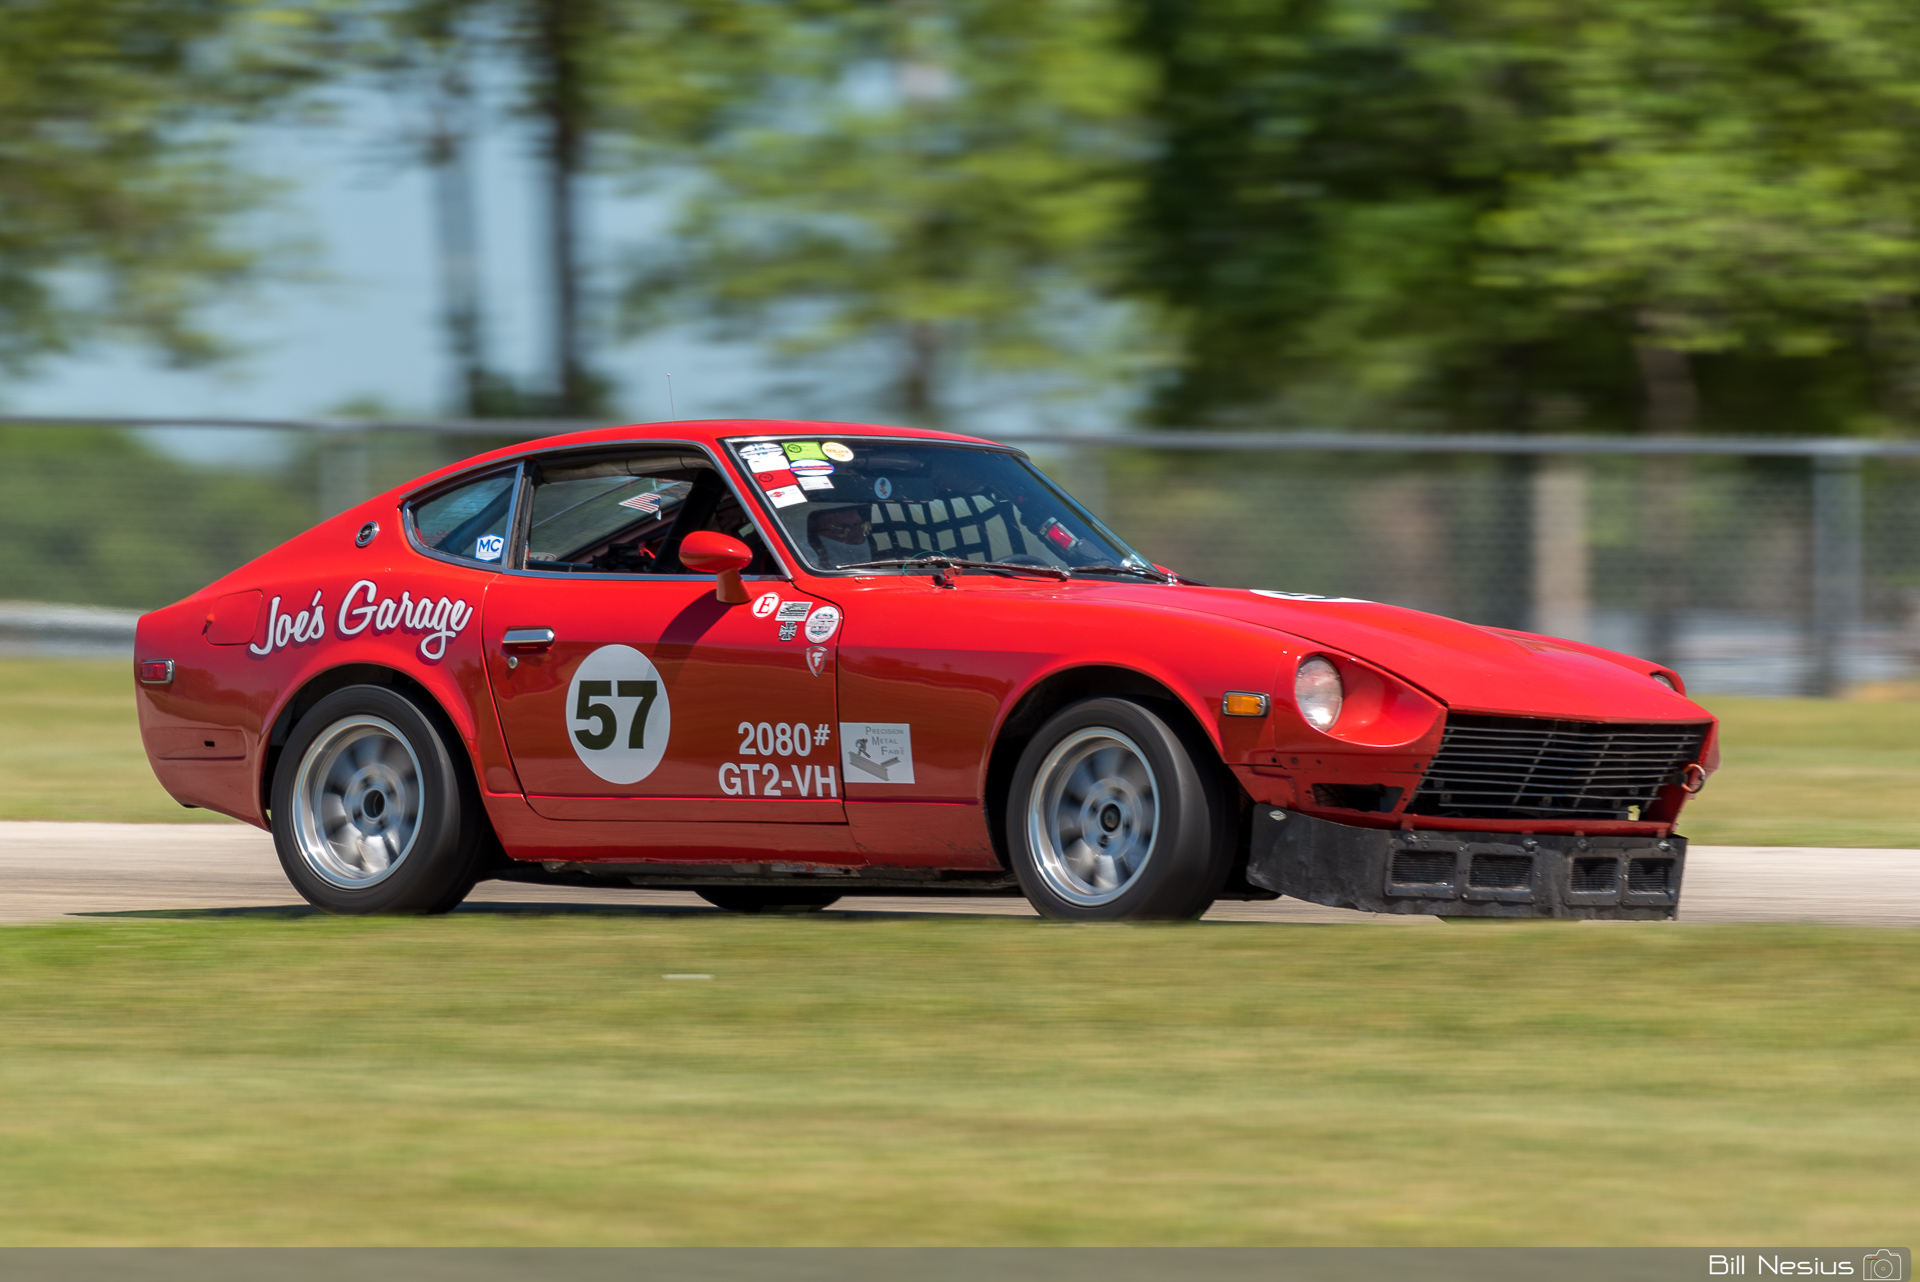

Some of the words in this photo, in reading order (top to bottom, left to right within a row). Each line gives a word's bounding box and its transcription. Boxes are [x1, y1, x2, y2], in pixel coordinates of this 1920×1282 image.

[478, 538, 501, 552] MC
[248, 588, 326, 657] Joe's
[337, 578, 475, 662] Garage
[755, 596, 776, 614] E
[573, 679, 658, 751] 57
[737, 721, 831, 757] 2080#
[718, 762, 838, 799] GT2-VH
